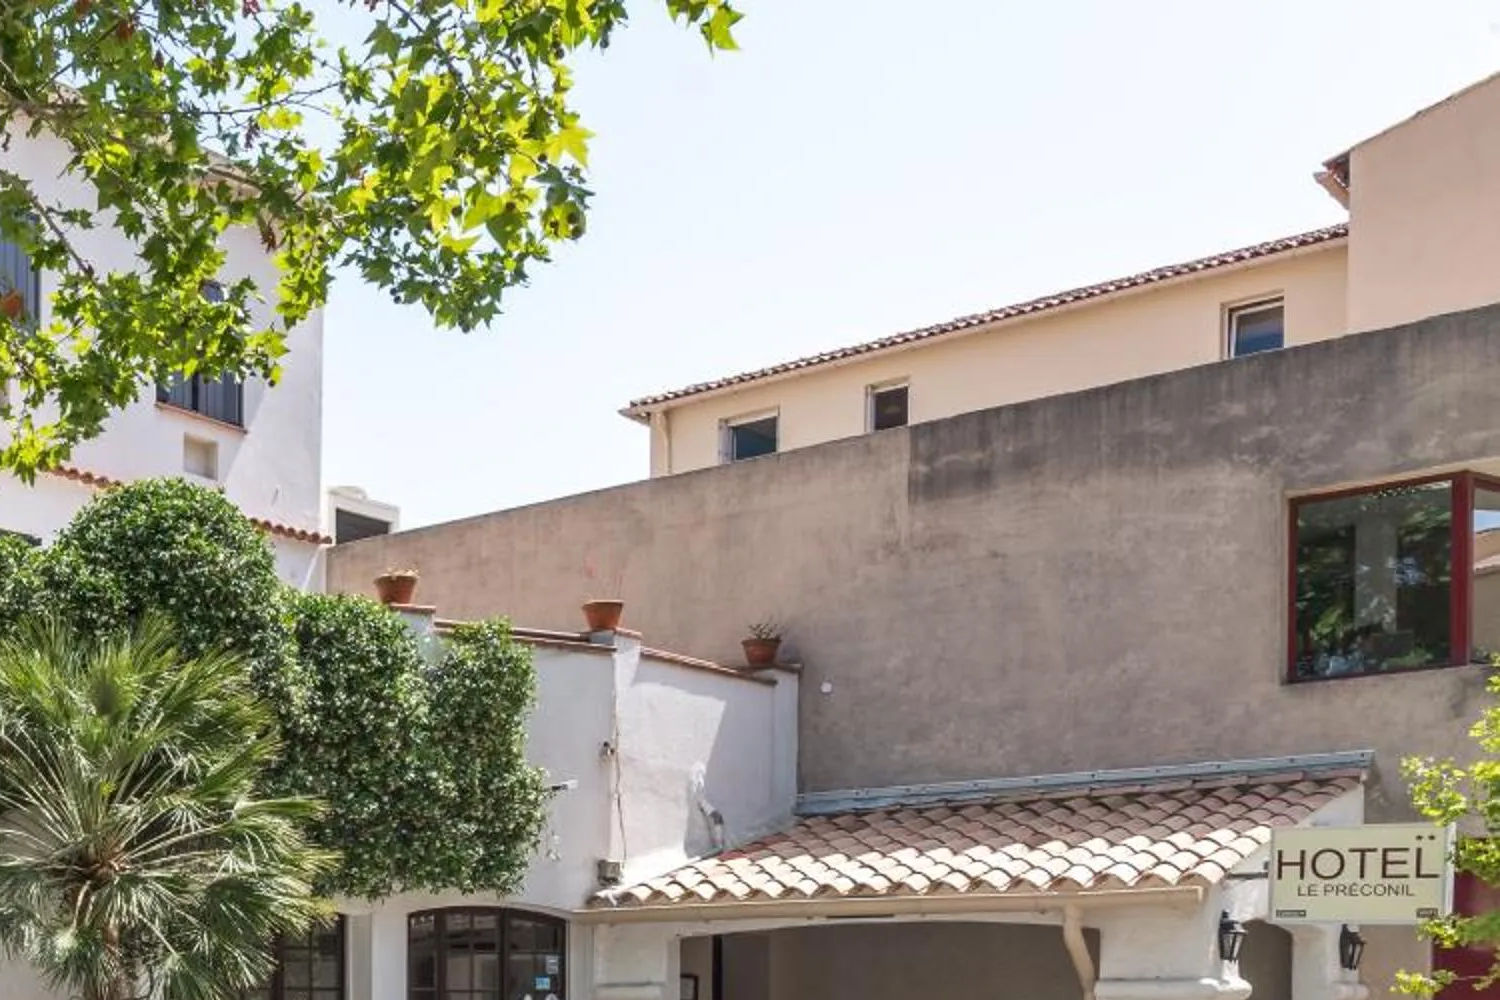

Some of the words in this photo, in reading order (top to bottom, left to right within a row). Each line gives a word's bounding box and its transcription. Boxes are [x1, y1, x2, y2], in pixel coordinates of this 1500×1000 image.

[1277, 848, 1440, 881] HOTEL
[1297, 883, 1319, 897] LE
[1323, 881, 1415, 897] PRÉCONIL
